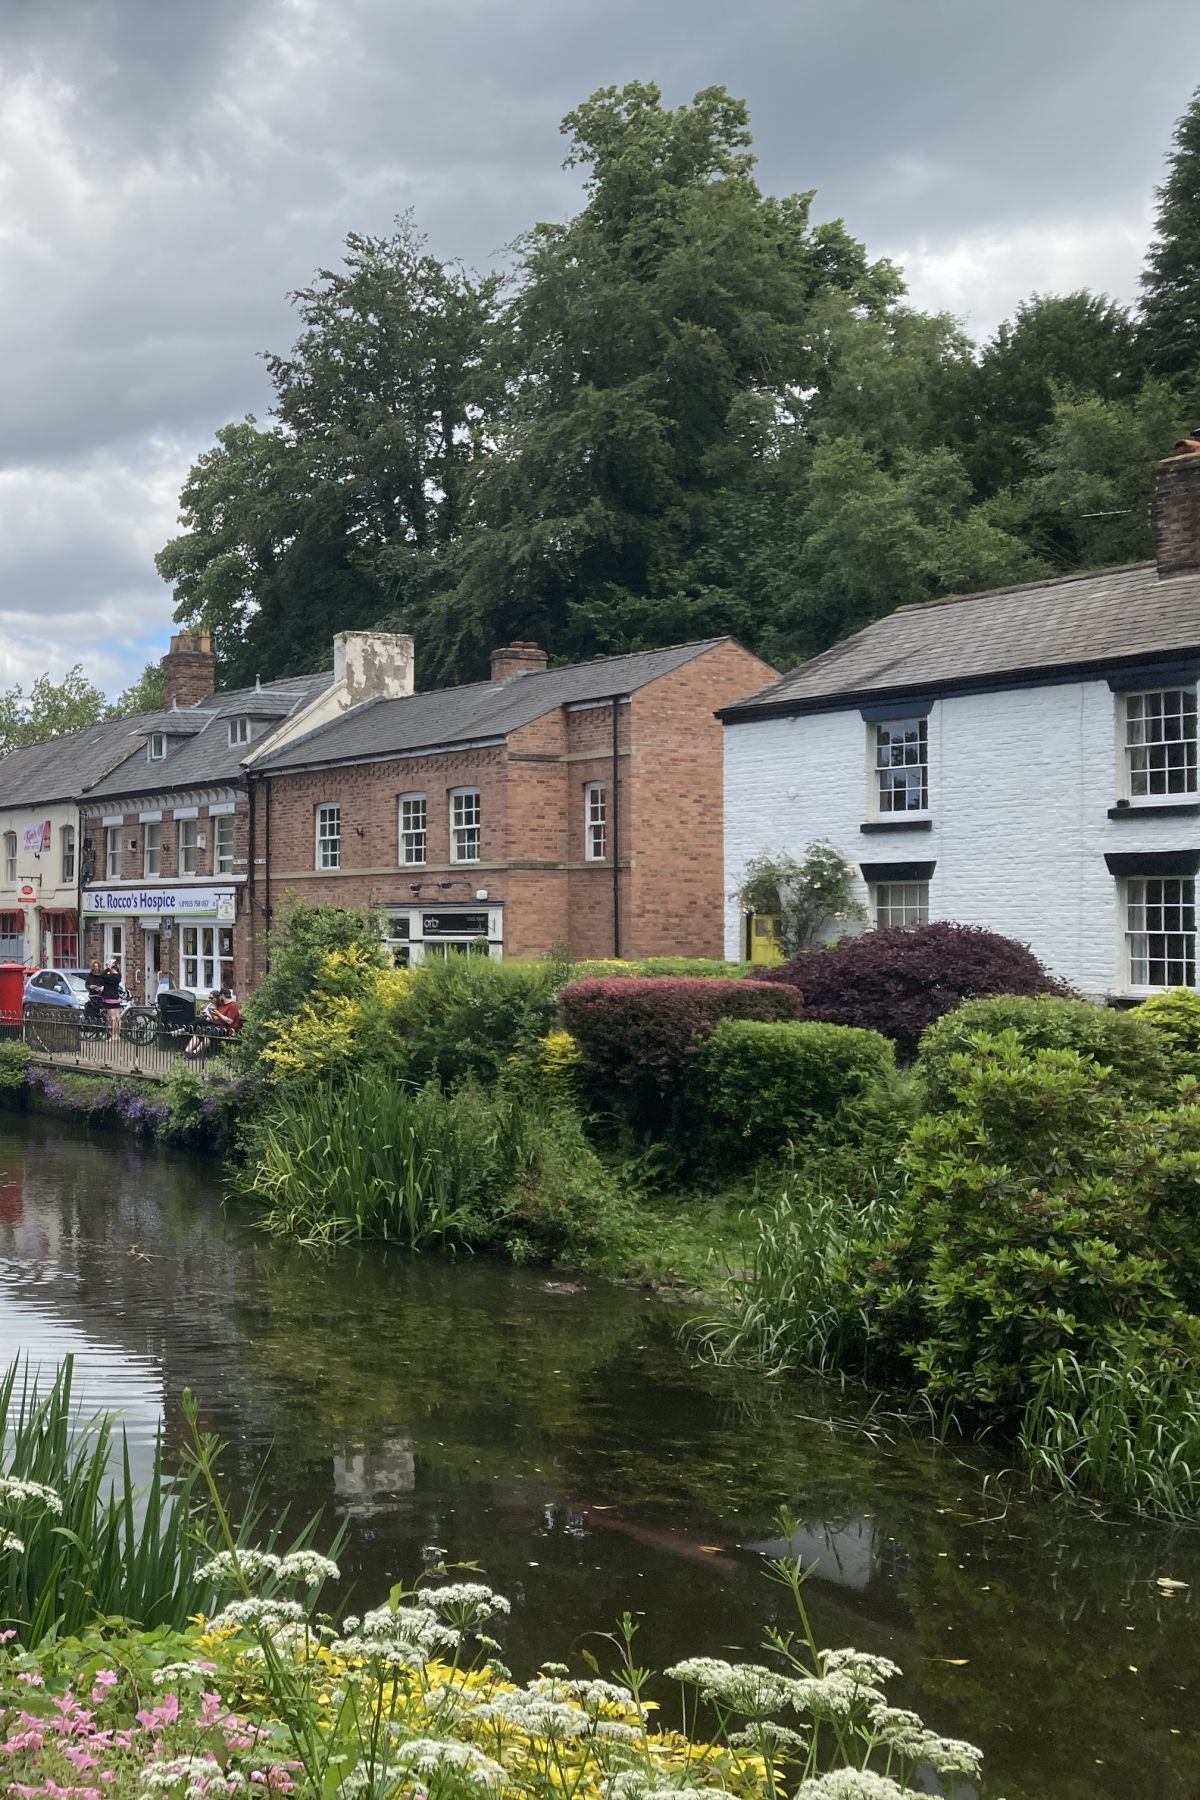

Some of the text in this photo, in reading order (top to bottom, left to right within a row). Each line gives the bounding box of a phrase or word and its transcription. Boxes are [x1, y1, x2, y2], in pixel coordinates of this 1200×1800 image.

[94, 893, 105, 909] St.
[106, 893, 138, 909] Rocco's
[139, 891, 176, 912] Hospice
